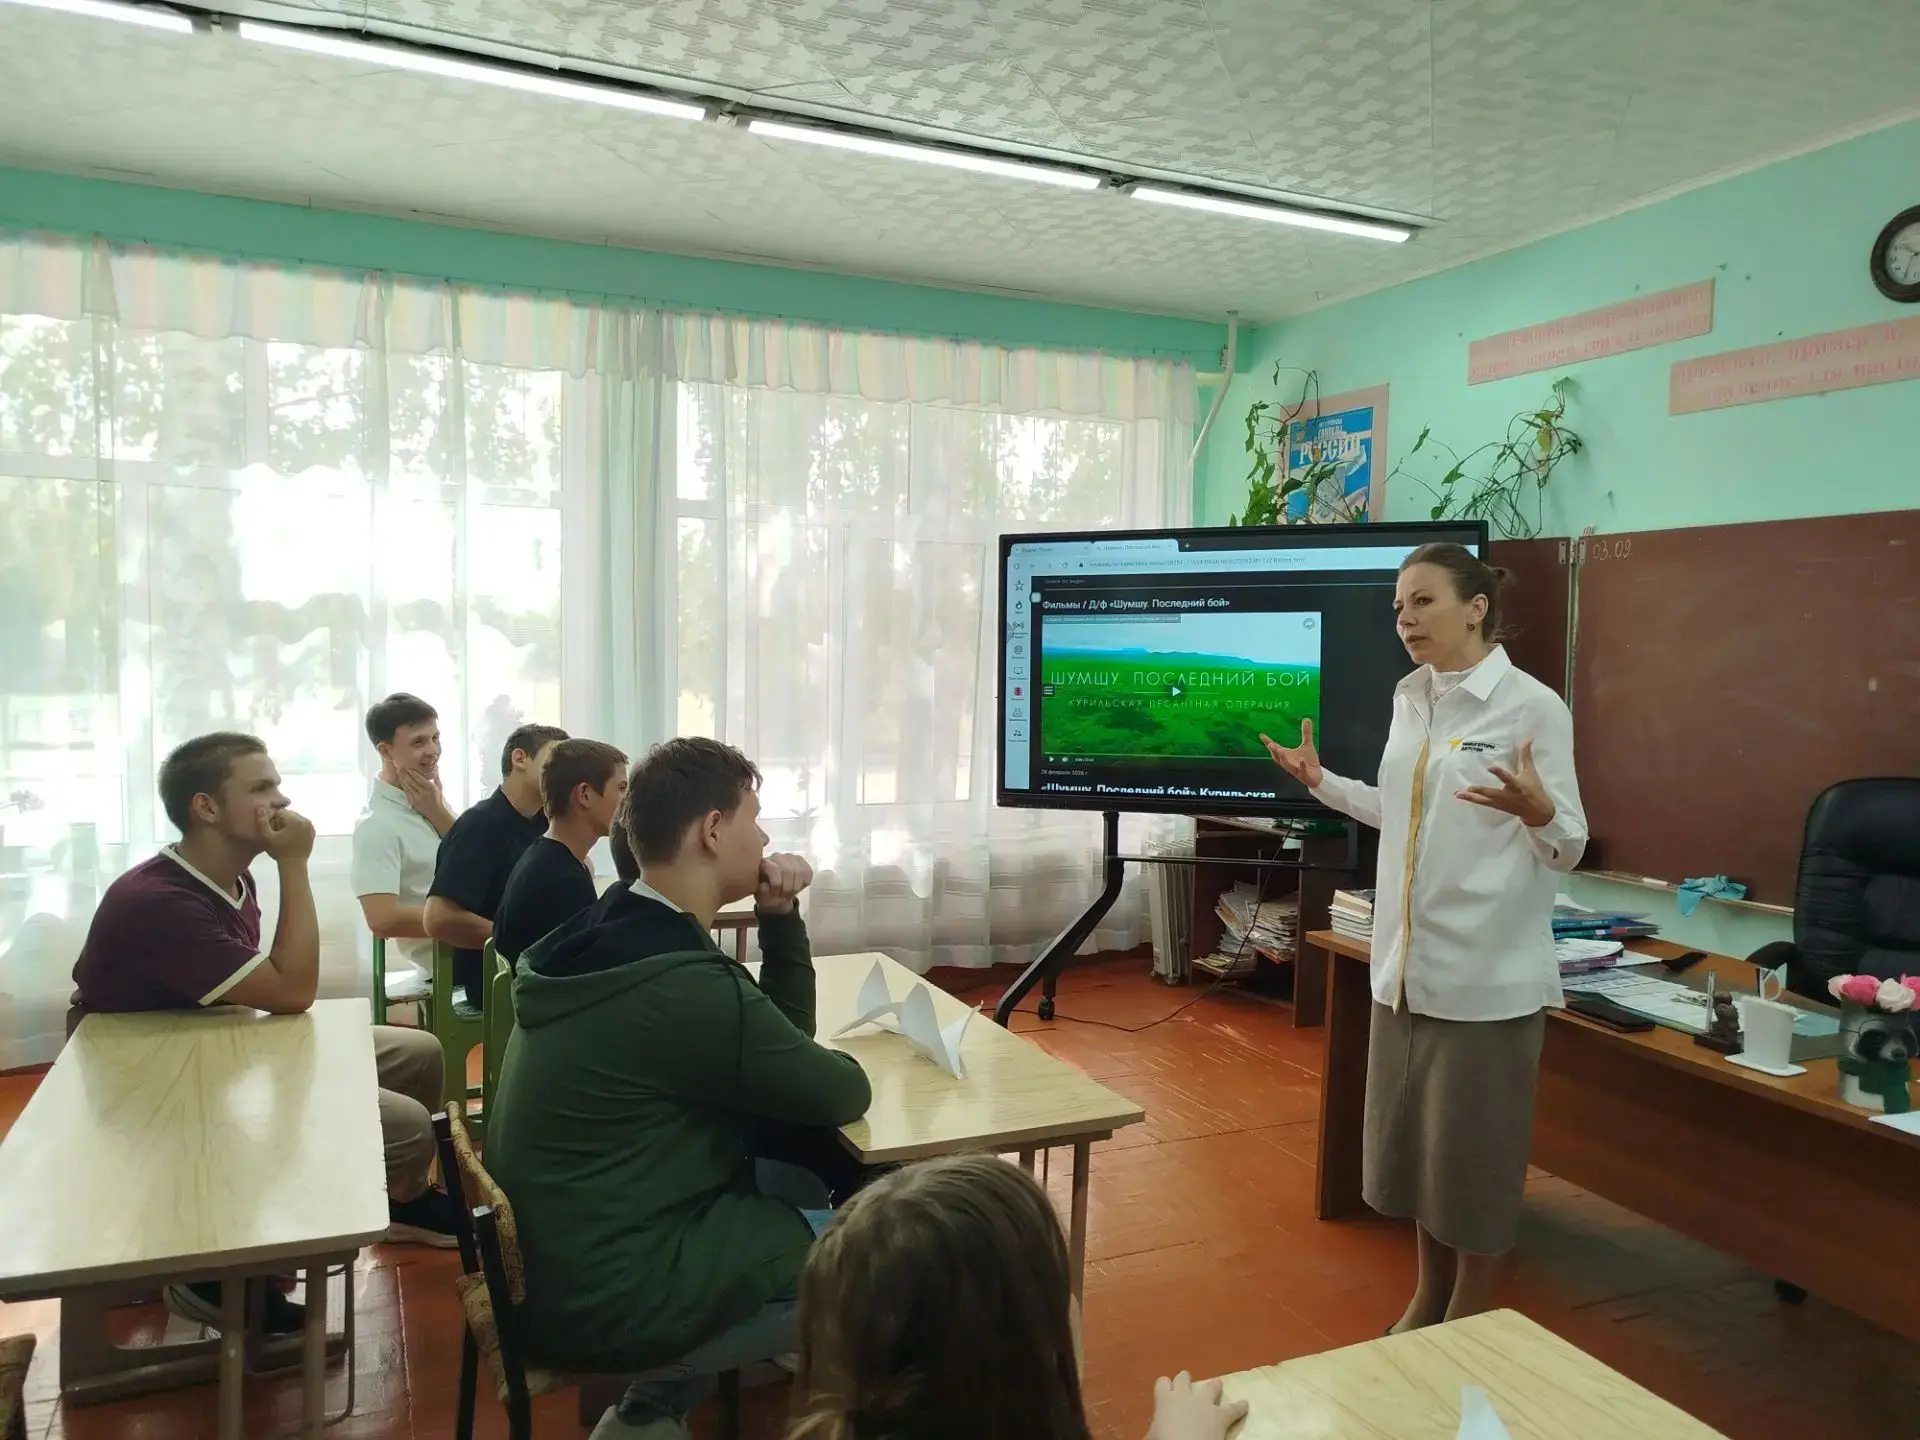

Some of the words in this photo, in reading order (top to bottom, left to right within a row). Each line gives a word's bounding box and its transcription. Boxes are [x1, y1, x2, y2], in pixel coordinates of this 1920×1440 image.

[1592, 537, 1631, 560] 03.09
[1042, 600, 1080, 609] Фильмы
[1088, 599, 1107, 610] Д/ф
[1109, 599, 1149, 610] «Шумшу.
[1152, 598, 1205, 609] Последний
[1207, 597, 1230, 607] бой»
[1051, 671, 1119, 685] ШУМШУ
[1133, 670, 1254, 687] ПОСЛЕДНИЙ
[1266, 670, 1310, 687] БОЙ
[1069, 699, 1142, 708] КУРИЛЬСКАЯ
